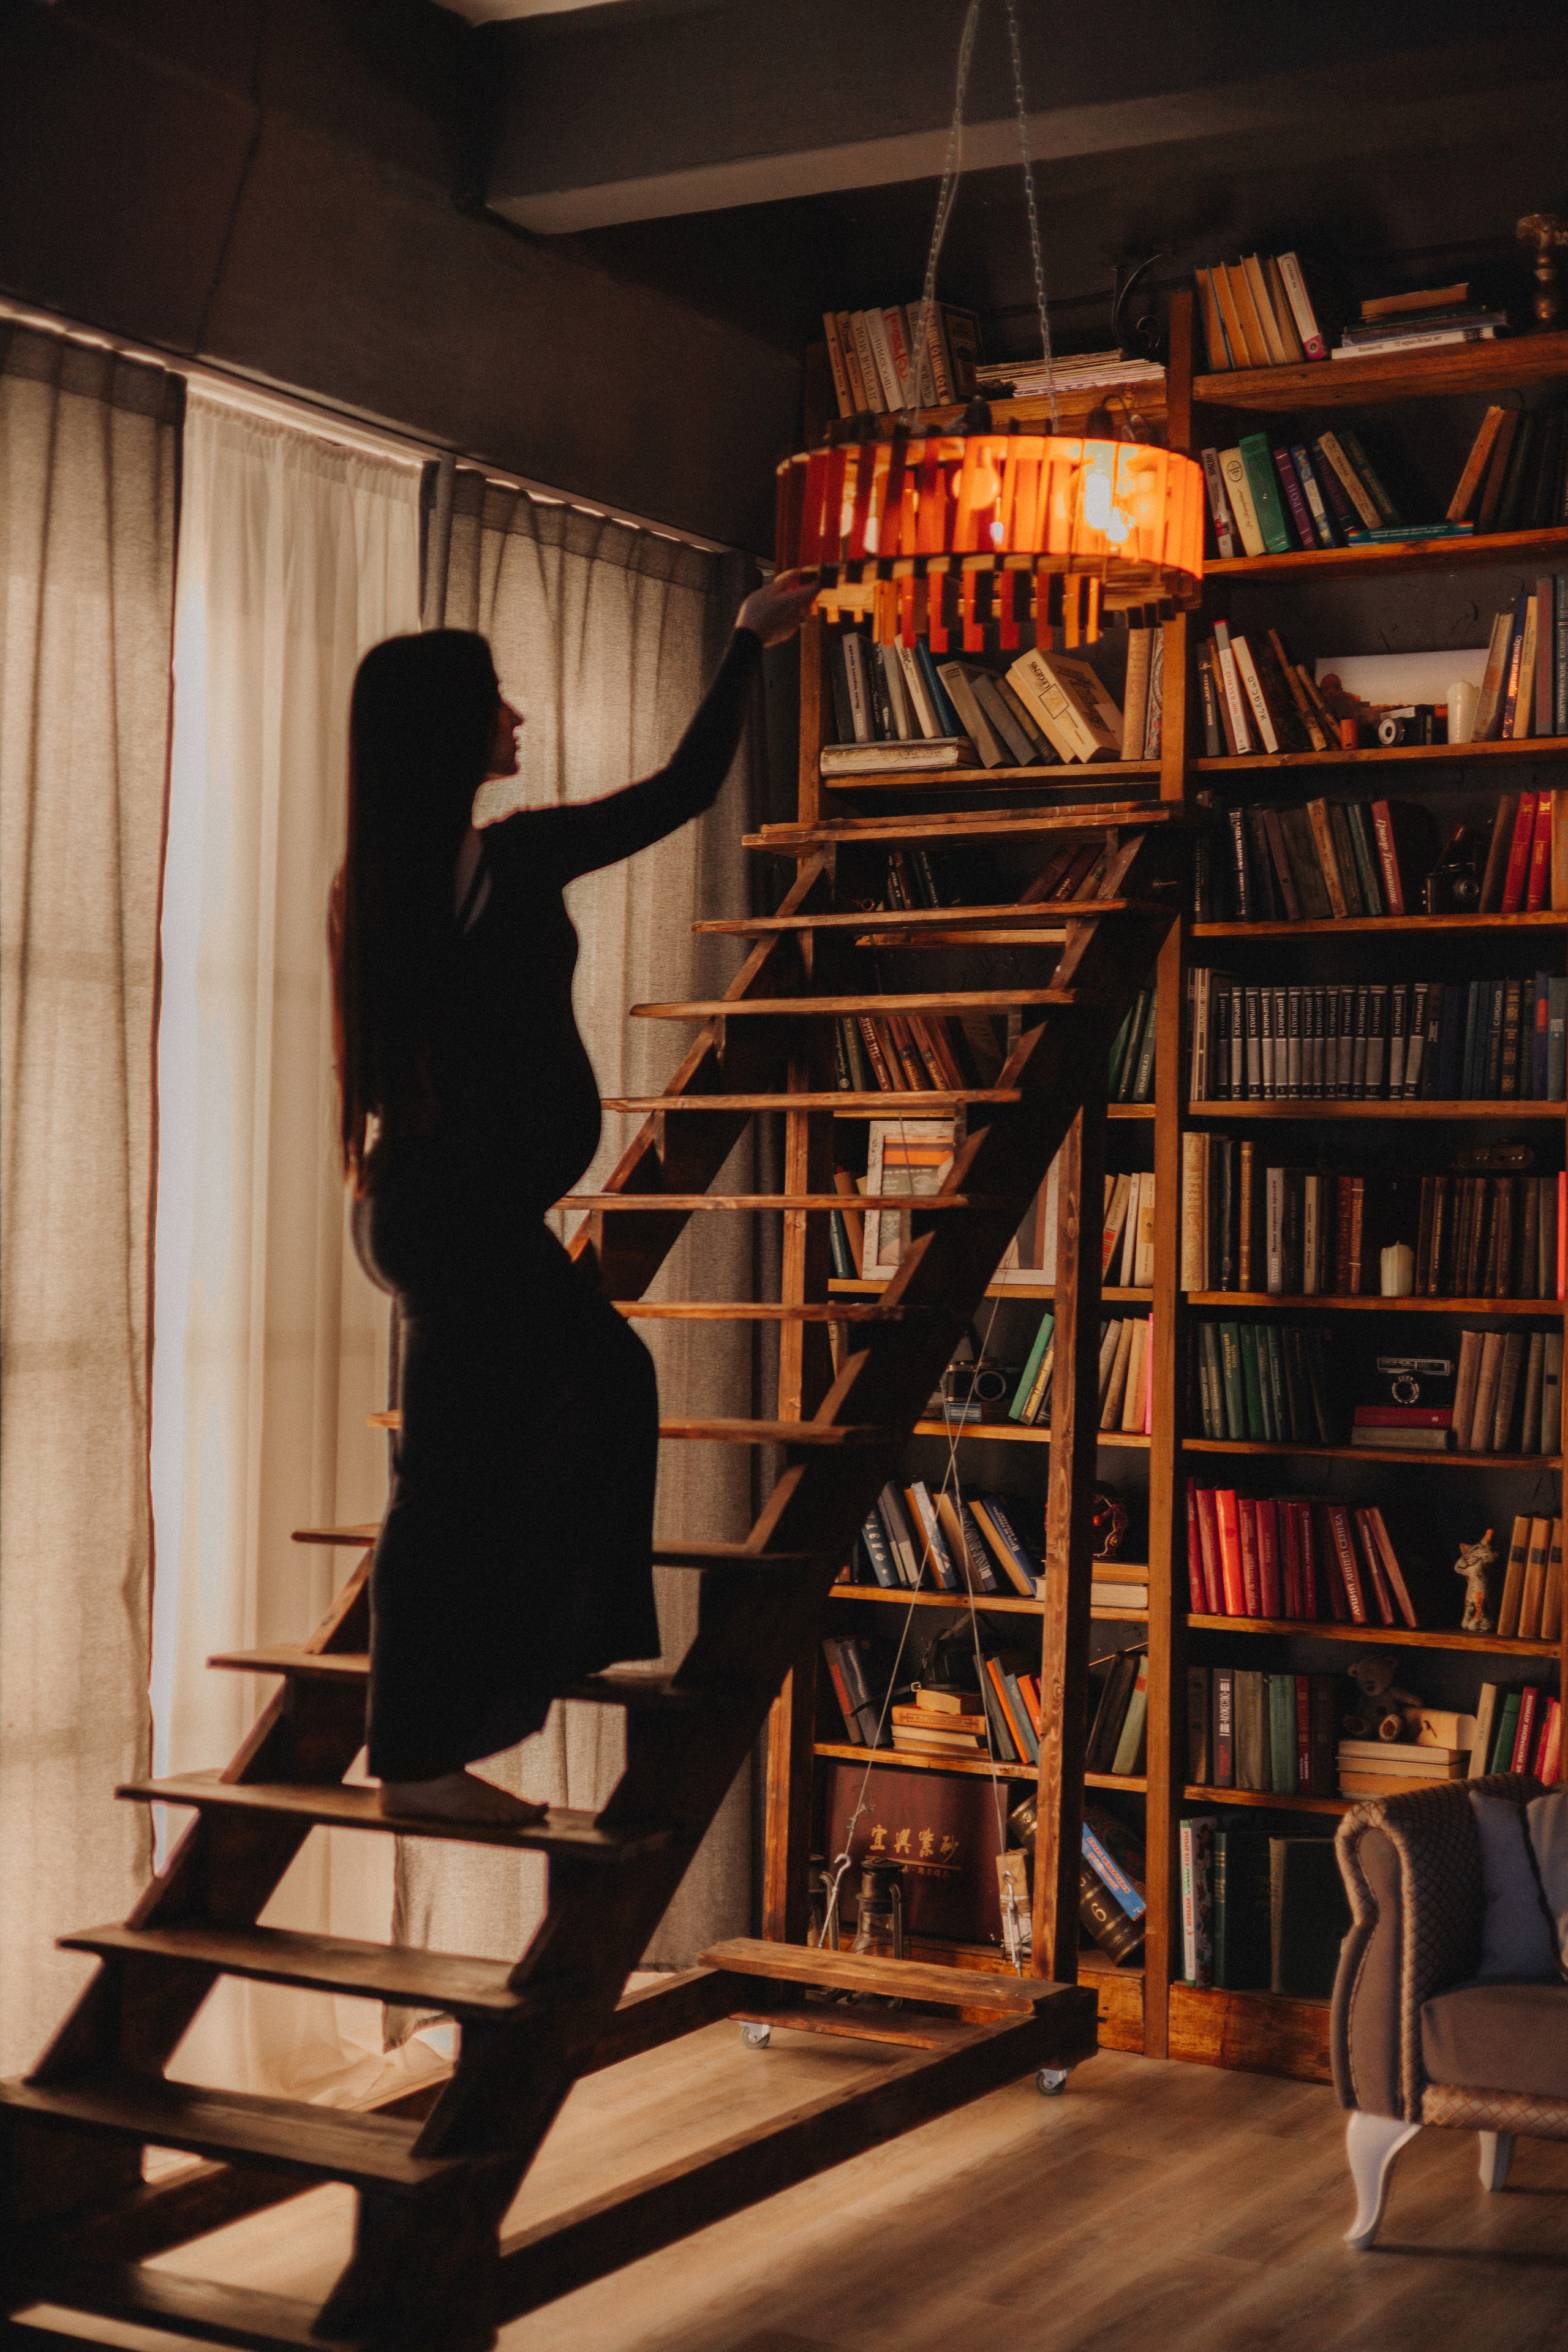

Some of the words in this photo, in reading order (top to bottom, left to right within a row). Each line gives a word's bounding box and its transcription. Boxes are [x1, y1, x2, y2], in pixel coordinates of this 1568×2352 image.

[861, 355, 877, 400] ДРУЗЬЯ
[1343, 995, 1351, 1034] М.ГОРЬКИЙ
[1373, 995, 1381, 1035] М.ГОРЬКИЙ
[1414, 993, 1424, 1033] М.ГОРЬКИЙ
[1138, 1054, 1150, 1093] СУВОРОВ
[1335, 1513, 1347, 1548] СЕНЕКА
[1346, 1583, 1360, 1615] ЛУЦИЙ
[1085, 1836, 1104, 1857] АТЛАС
[1100, 1855, 1131, 1894] ЖИВОТНЫХ
